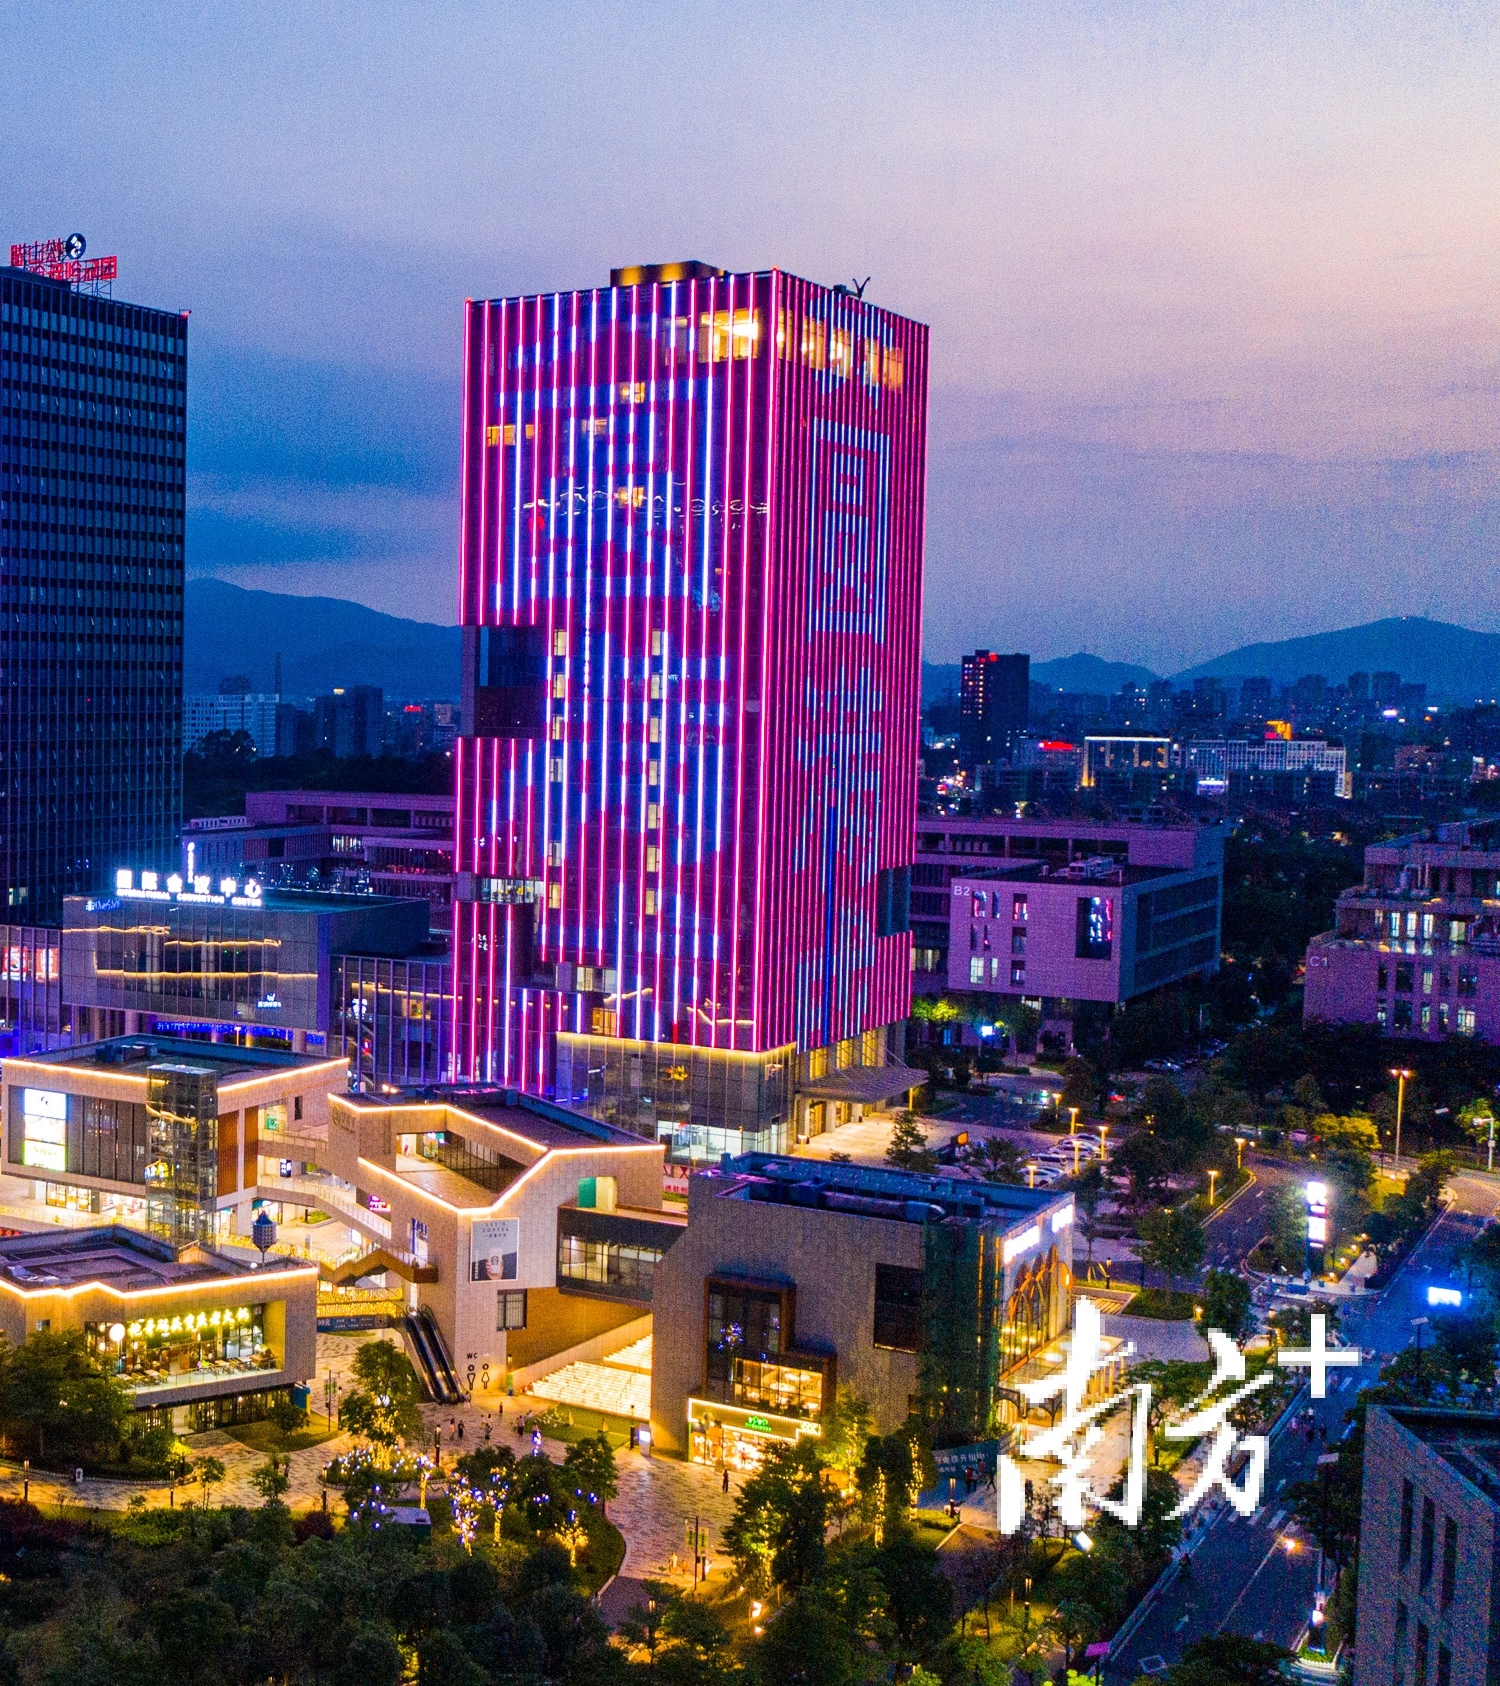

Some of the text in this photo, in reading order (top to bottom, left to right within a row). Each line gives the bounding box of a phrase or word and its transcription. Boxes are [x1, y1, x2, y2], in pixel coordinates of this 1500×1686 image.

[116, 869, 262, 899] 国际会议中心
[953, 885, 971, 896] B2
[1310, 955, 1328, 967] C1
[466, 1352, 479, 1360] WC
